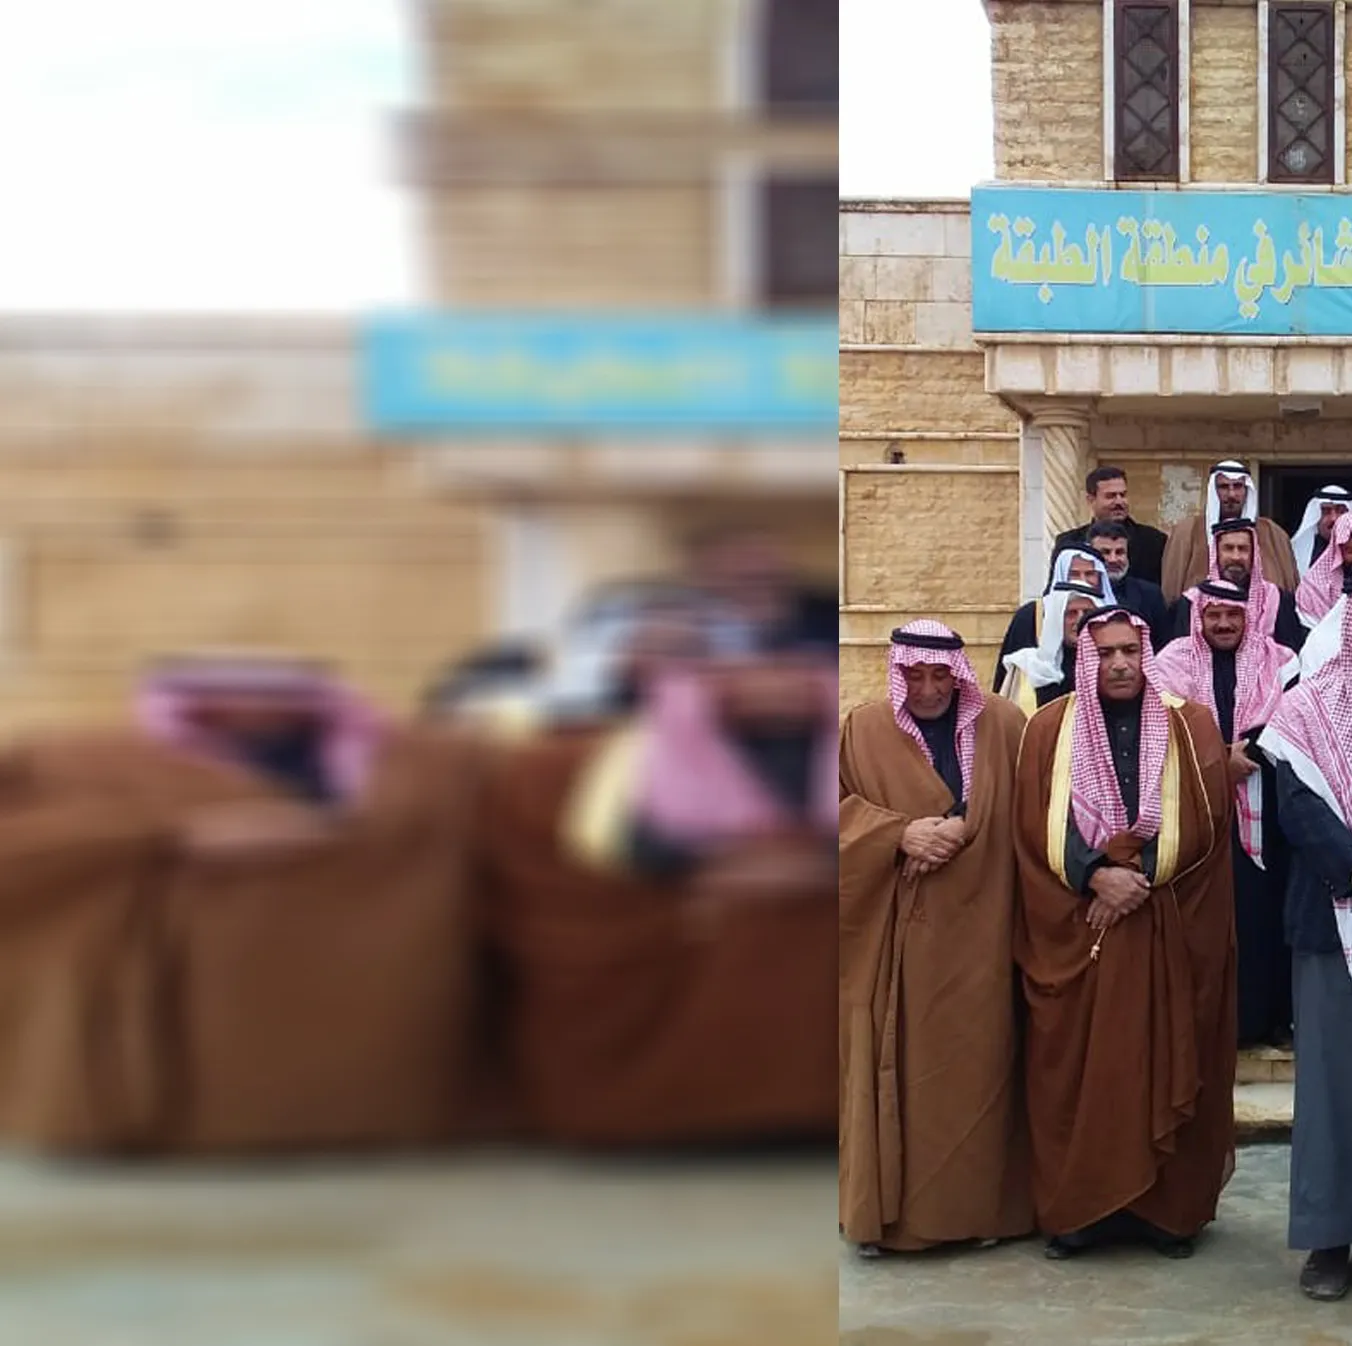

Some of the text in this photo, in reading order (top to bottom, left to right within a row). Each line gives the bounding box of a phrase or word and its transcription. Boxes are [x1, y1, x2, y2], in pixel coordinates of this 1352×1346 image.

[987, 213, 1112, 304] الطبقة
[1116, 216, 1229, 286] منطقة
[1234, 218, 1277, 319] في
